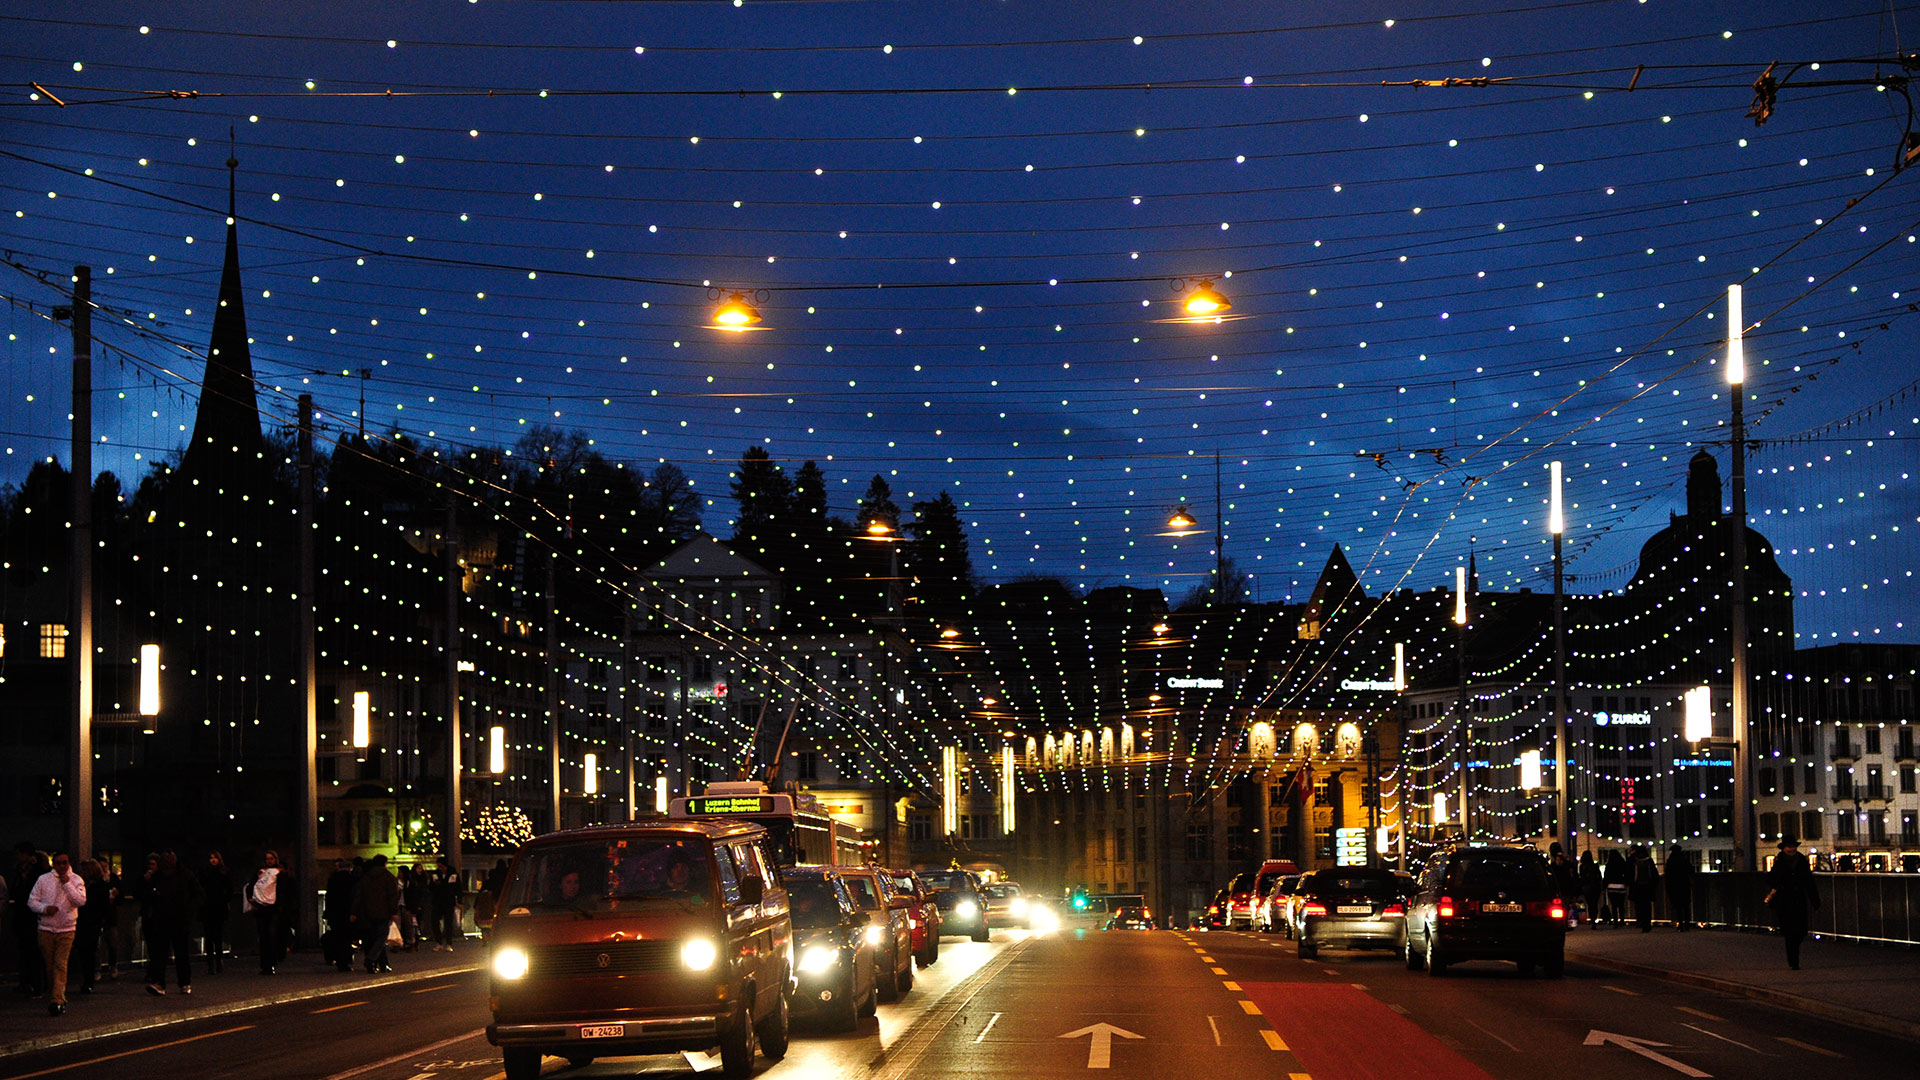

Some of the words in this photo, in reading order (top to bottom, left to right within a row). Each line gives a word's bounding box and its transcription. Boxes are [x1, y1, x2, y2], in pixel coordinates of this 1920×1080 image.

[1611, 713, 1651, 725] ZURICH
[688, 800, 696, 813] 1
[704, 799, 731, 807] Luzern
[731, 797, 761, 807] Bahnhof
